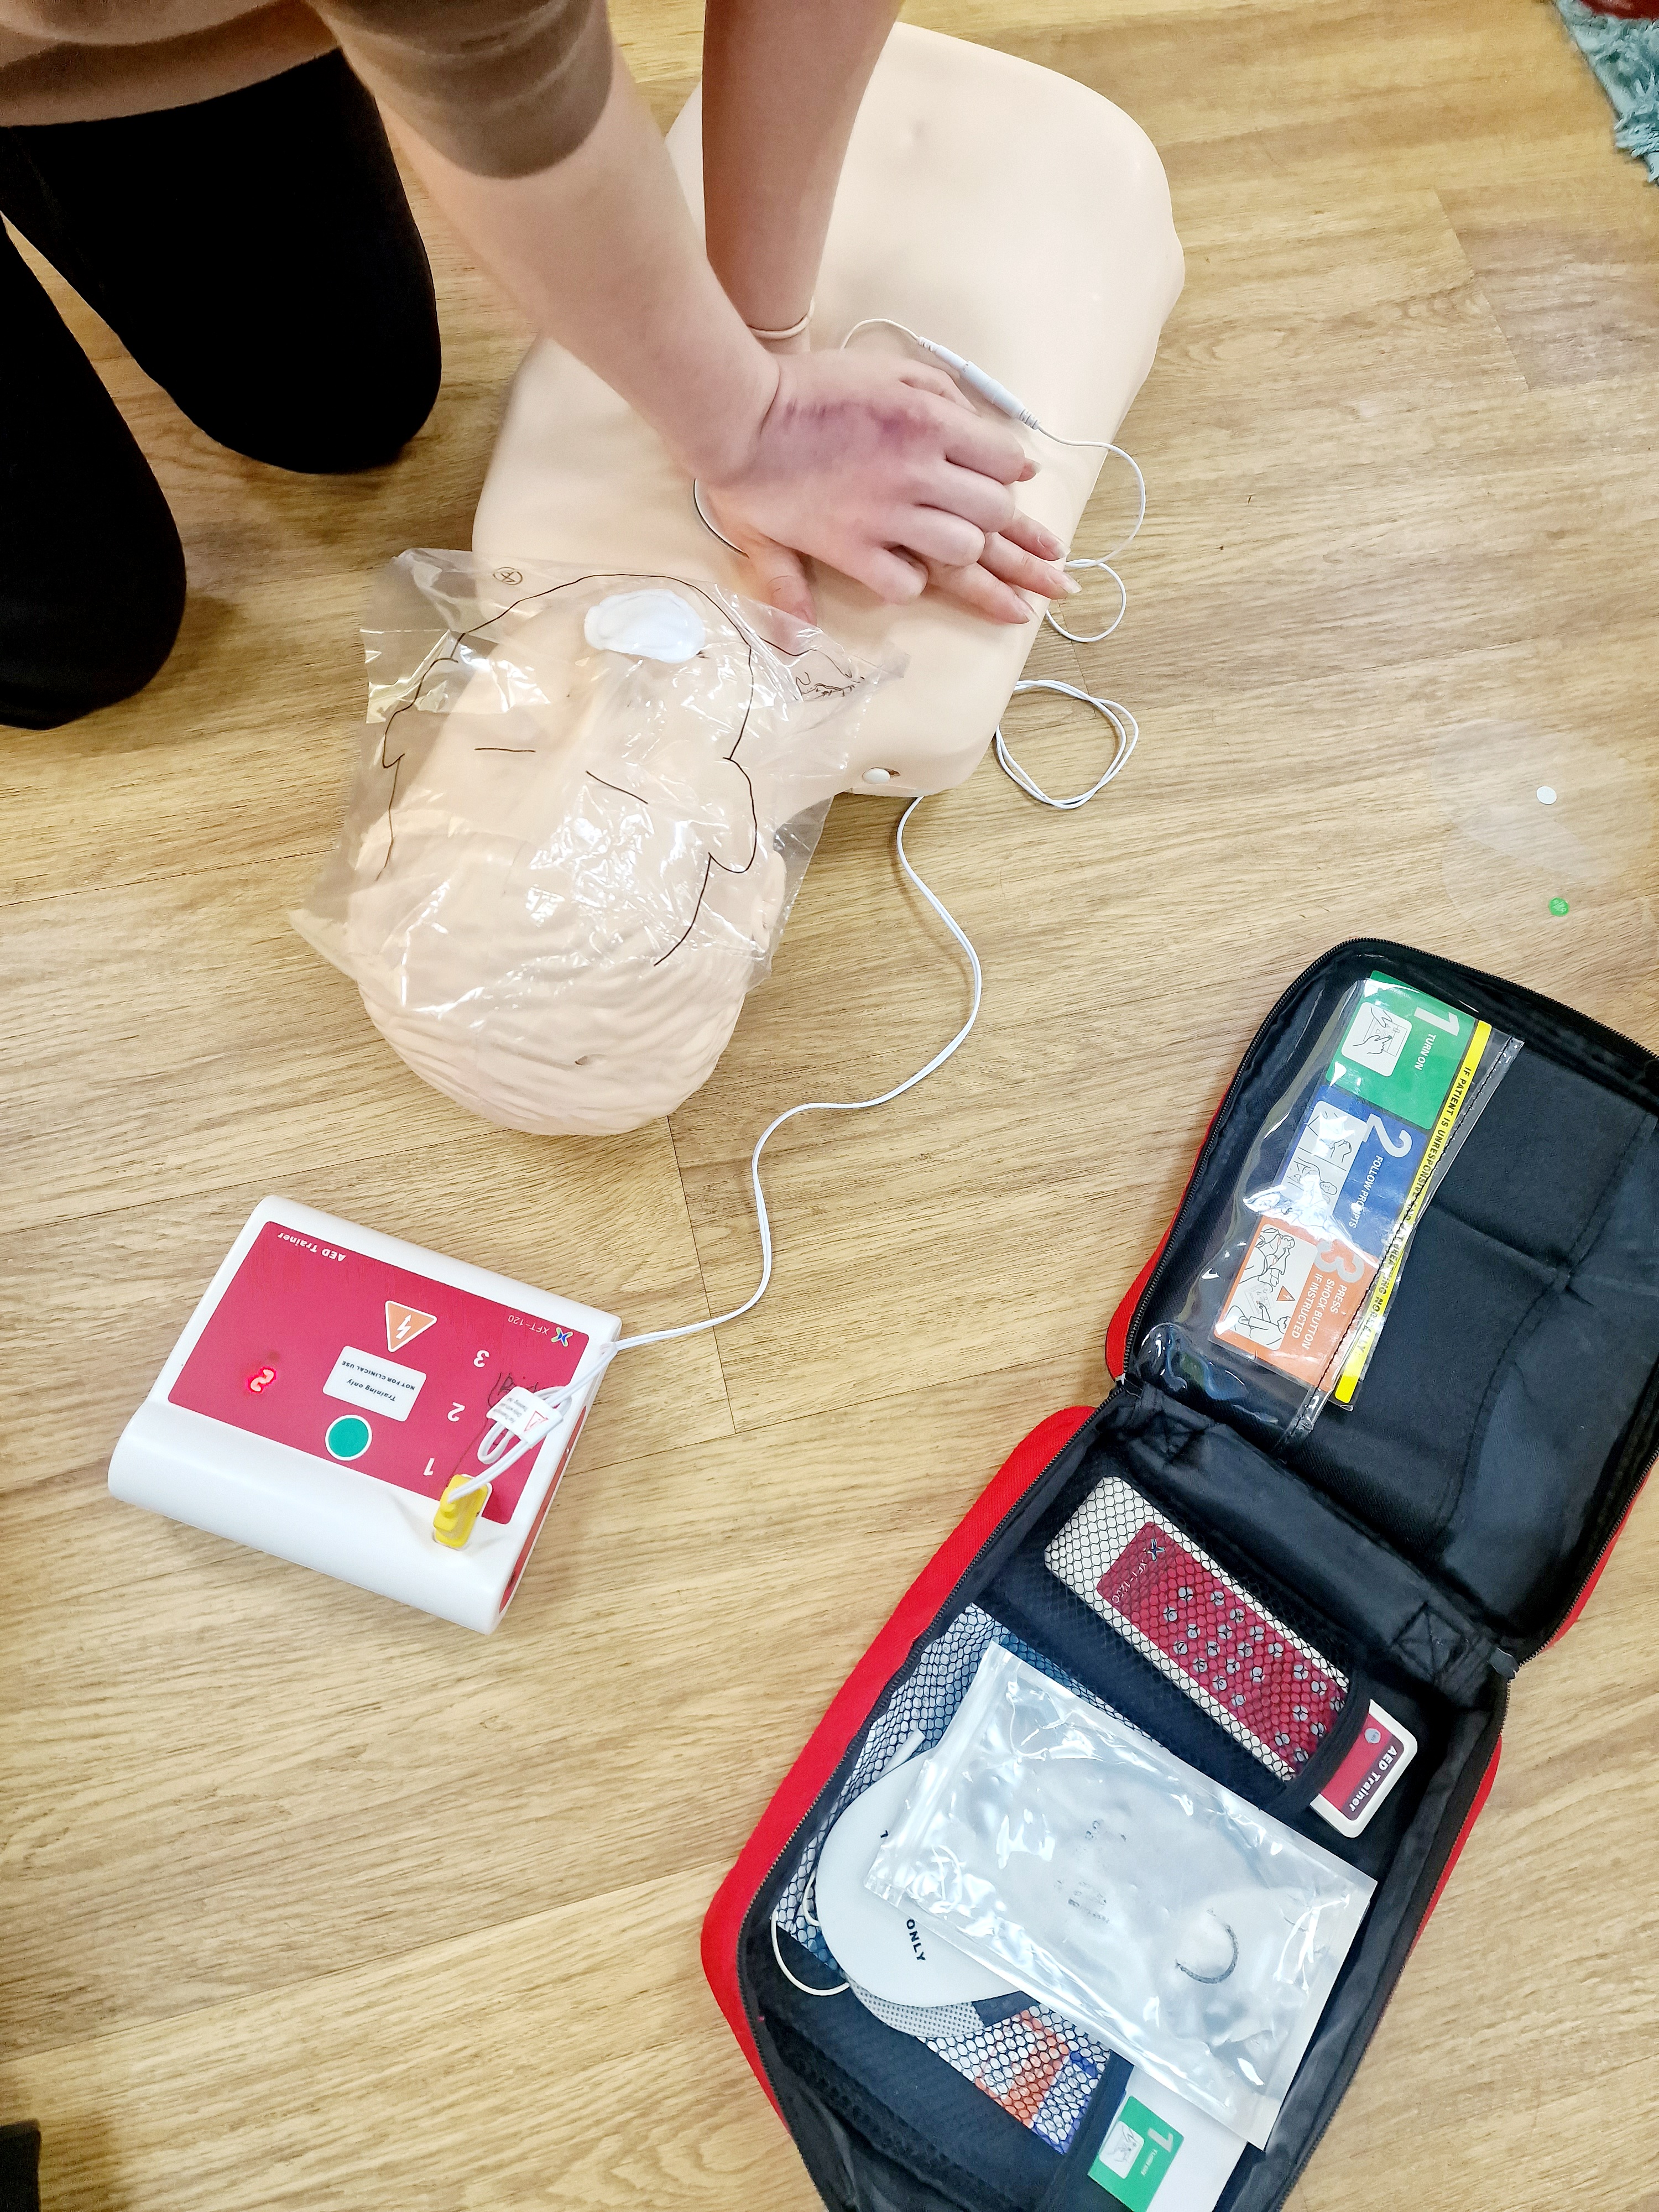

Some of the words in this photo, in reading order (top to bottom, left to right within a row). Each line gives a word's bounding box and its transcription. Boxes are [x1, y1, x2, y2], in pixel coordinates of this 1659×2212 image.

[1413, 1006, 1460, 1036] 1
[1420, 1033, 1437, 1058] TURN
[1414, 1056, 1426, 1071] ON
[1463, 1067, 1472, 1077] IF
[1446, 1078, 1467, 1117] PATIENT
[1441, 1118, 1451, 1128] IS
[1362, 1113, 1413, 1158] 2
[1363, 1154, 1383, 1192] FOLLOW
[277, 1232, 318, 1253] Trainer
[321, 1248, 346, 1262] AED
[1314, 1240, 1365, 1283] 3
[1314, 1272, 1323, 1283] IF
[1317, 1279, 1335, 1311] SHOCK
[1330, 1284, 1348, 1314] PRESS
[1292, 1282, 1320, 1339] INSTRUCTED
[508, 1314, 550, 1335] XFT-120
[1302, 1310, 1323, 1350] BUTTON
[473, 1350, 489, 1368] 3
[357, 1365, 386, 1380] CLINICAL
[387, 1376, 401, 1385] FOR
[347, 1379, 363, 1389] only
[364, 1385, 397, 1401] Training
[401, 1383, 415, 1391] NOT
[447, 1402, 466, 1422] 2
[423, 1458, 435, 1476] 1
[1379, 1745, 1398, 1771] AED
[1349, 1771, 1381, 1812] Trainer
[906, 1919, 926, 1961] ONLY
[1147, 2127, 1173, 2153] 1
